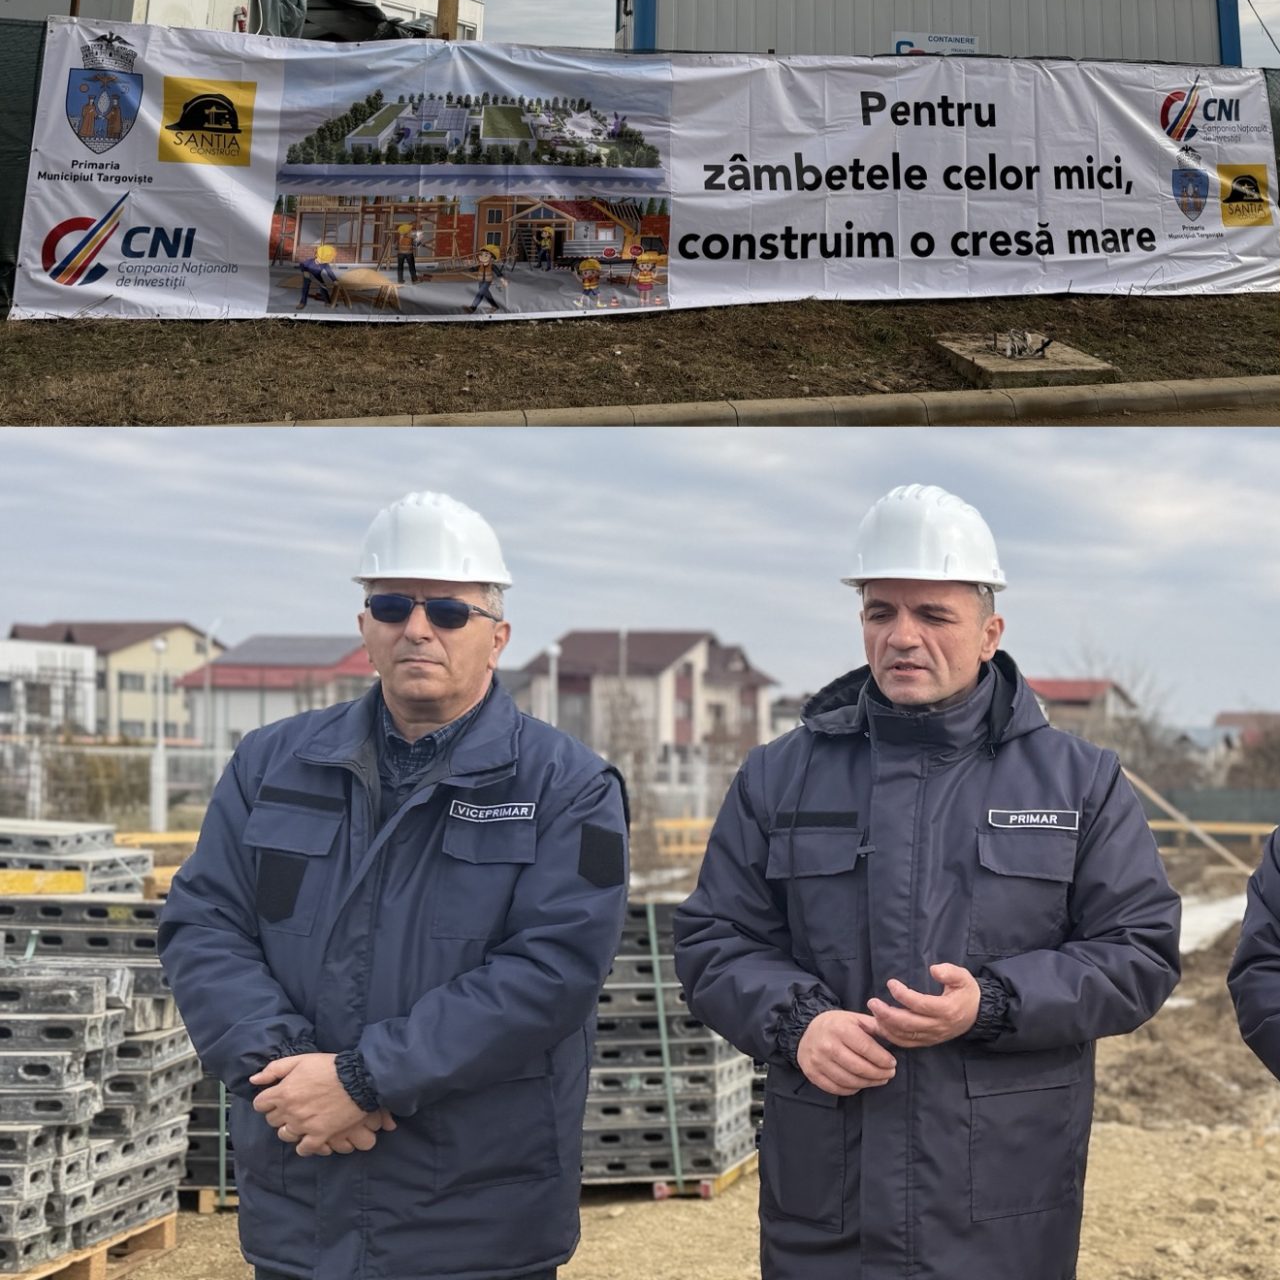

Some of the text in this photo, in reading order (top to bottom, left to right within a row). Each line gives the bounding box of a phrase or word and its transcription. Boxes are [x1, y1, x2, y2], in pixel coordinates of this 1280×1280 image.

[928, 35, 975, 44] CONTAINERE
[860, 91, 997, 127] Pentru
[1203, 98, 1240, 121] CNI
[173, 132, 241, 150] SANTIA
[190, 147, 240, 157] CONSTRUCT
[71, 160, 120, 171] Primaria
[37, 171, 94, 184] Municipiul
[703, 152, 1134, 196] zâmbetele celor mici,
[1228, 203, 1264, 215] SANTIA
[121, 227, 196, 258] CNI
[677, 222, 1157, 260] construim o cresă mare
[117, 262, 178, 276] Compania
[115, 276, 131, 287] de
[457, 805, 529, 818] VICEPRIMAR
[1009, 814, 1058, 824] PRIMAR
